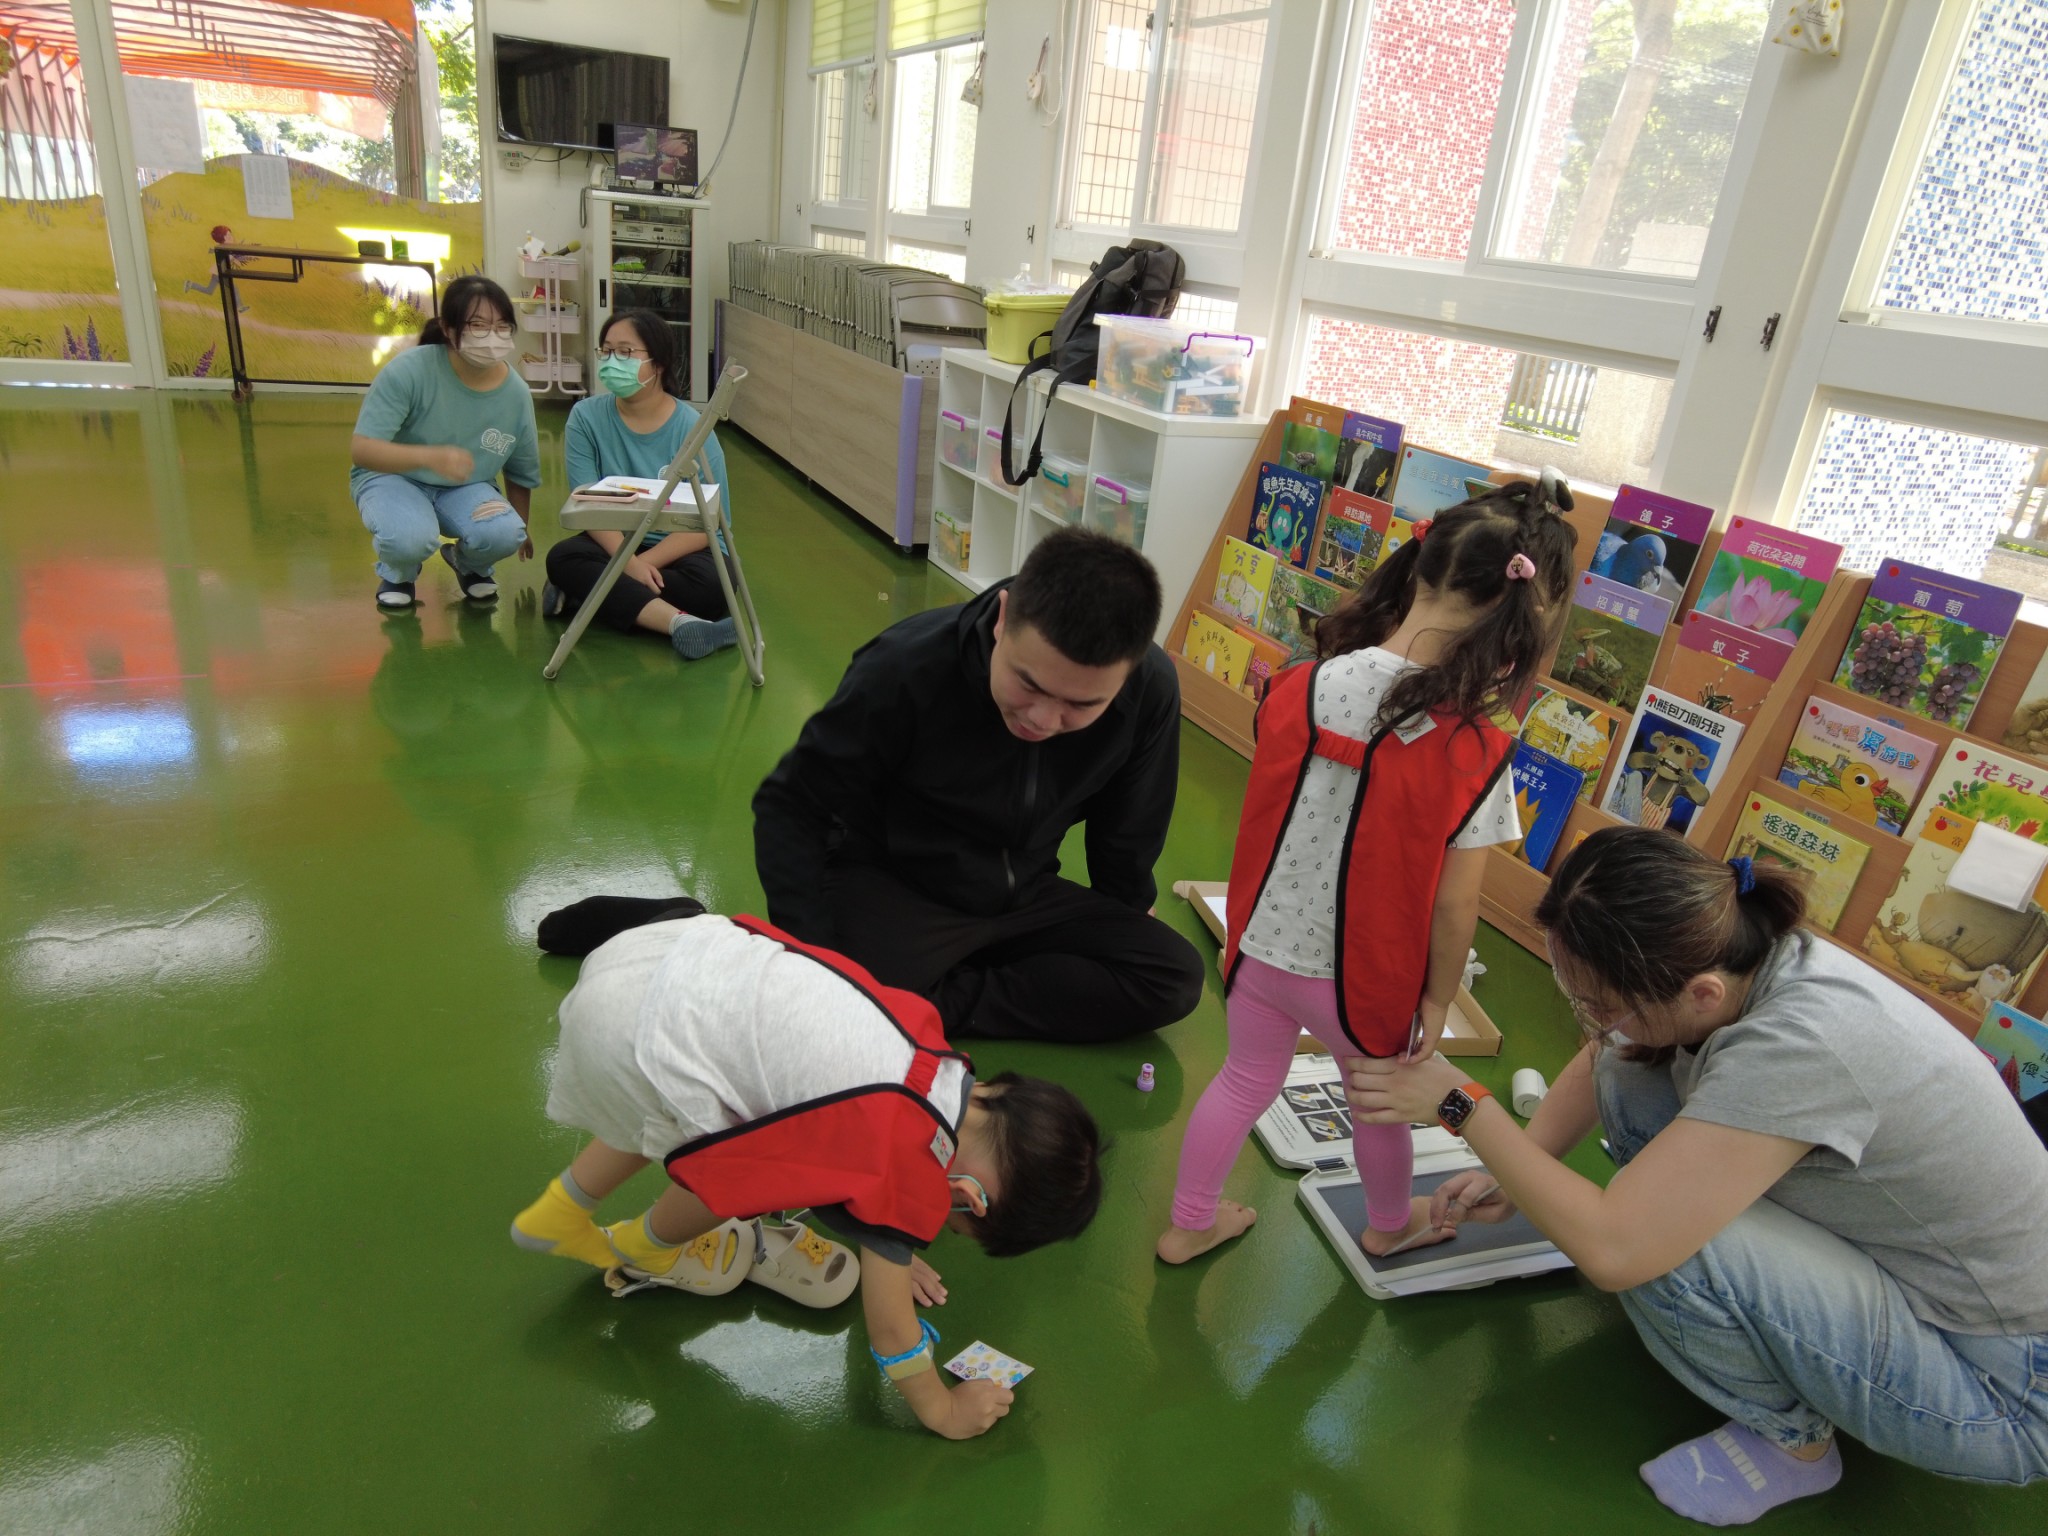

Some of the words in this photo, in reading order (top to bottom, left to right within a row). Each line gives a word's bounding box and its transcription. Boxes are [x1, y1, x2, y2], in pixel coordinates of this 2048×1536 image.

[1639, 508, 1675, 529] 鴿子
[1233, 548, 1262, 575] 分享
[1746, 540, 1807, 569] 荷花朵朵開
[1595, 594, 1640, 622] 招潮蟹
[1912, 589, 1965, 617] 葡萄
[1711, 639, 1750, 663] 蚊子
[1512, 767, 1548, 791] 快樂王子
[1762, 812, 1840, 863] 搖滾森林
